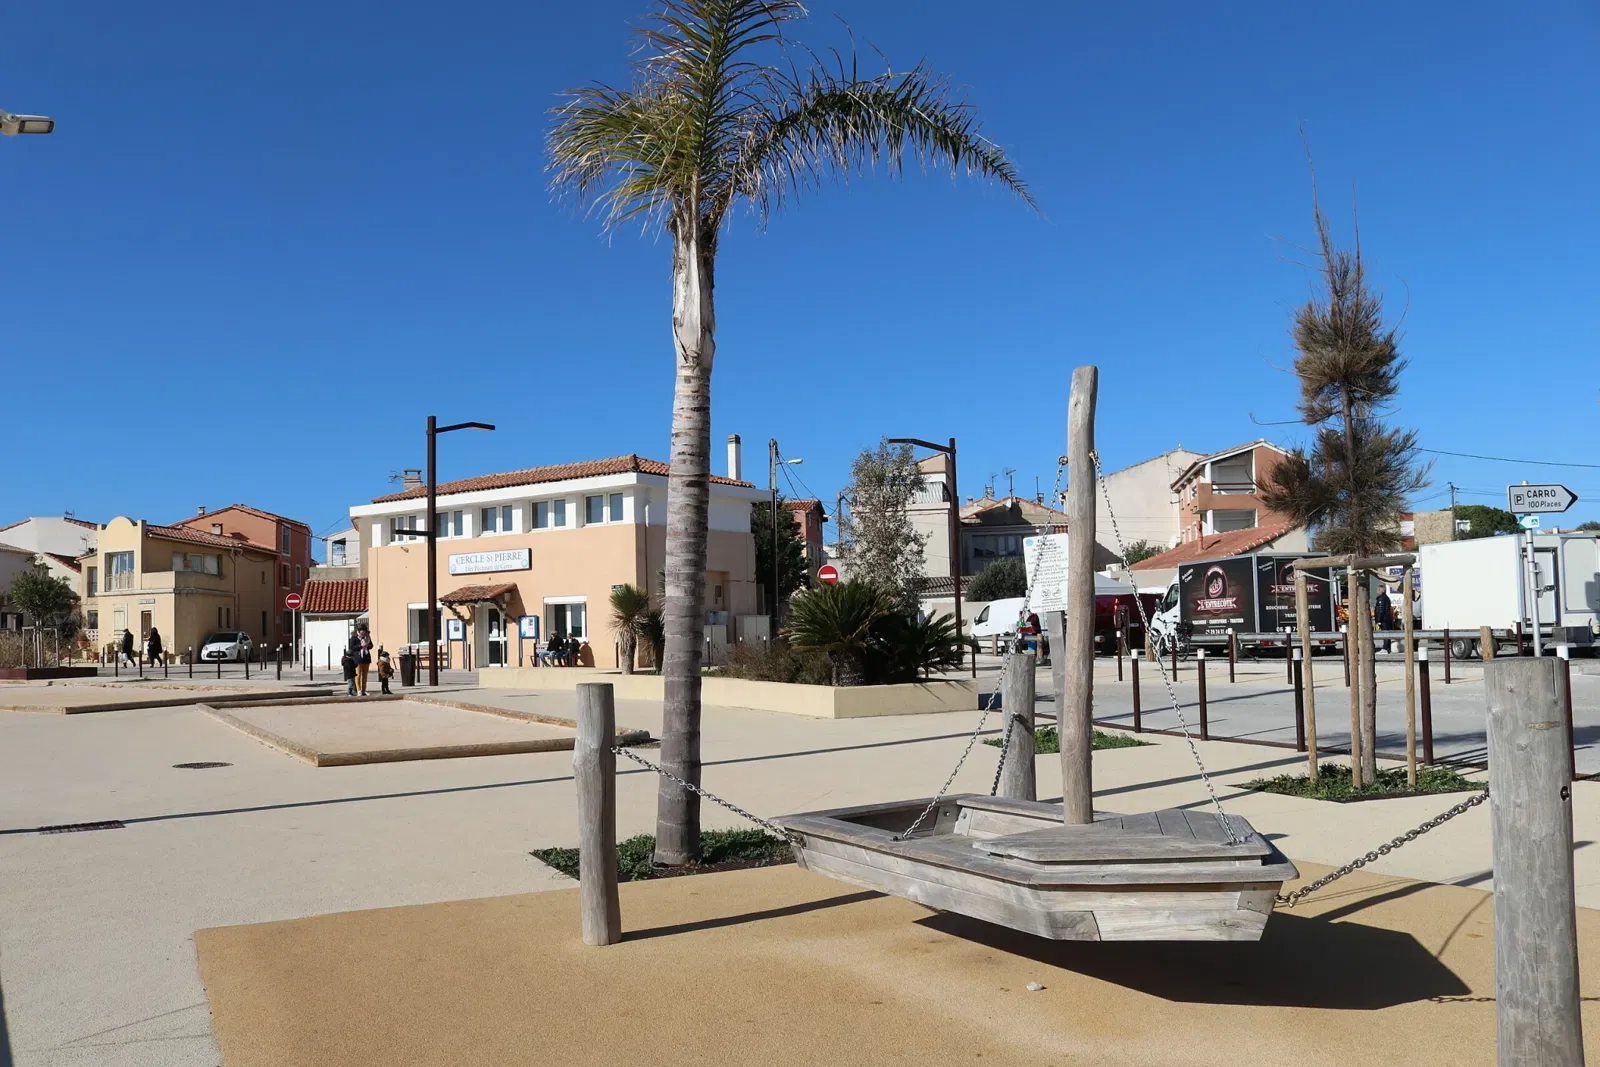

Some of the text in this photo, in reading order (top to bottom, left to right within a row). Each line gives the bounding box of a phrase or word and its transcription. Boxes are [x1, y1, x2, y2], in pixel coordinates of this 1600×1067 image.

[1526, 490, 1556, 498] CARRO
[456, 554, 485, 564] CERCLE
[494, 552, 522, 562] PIERRE
